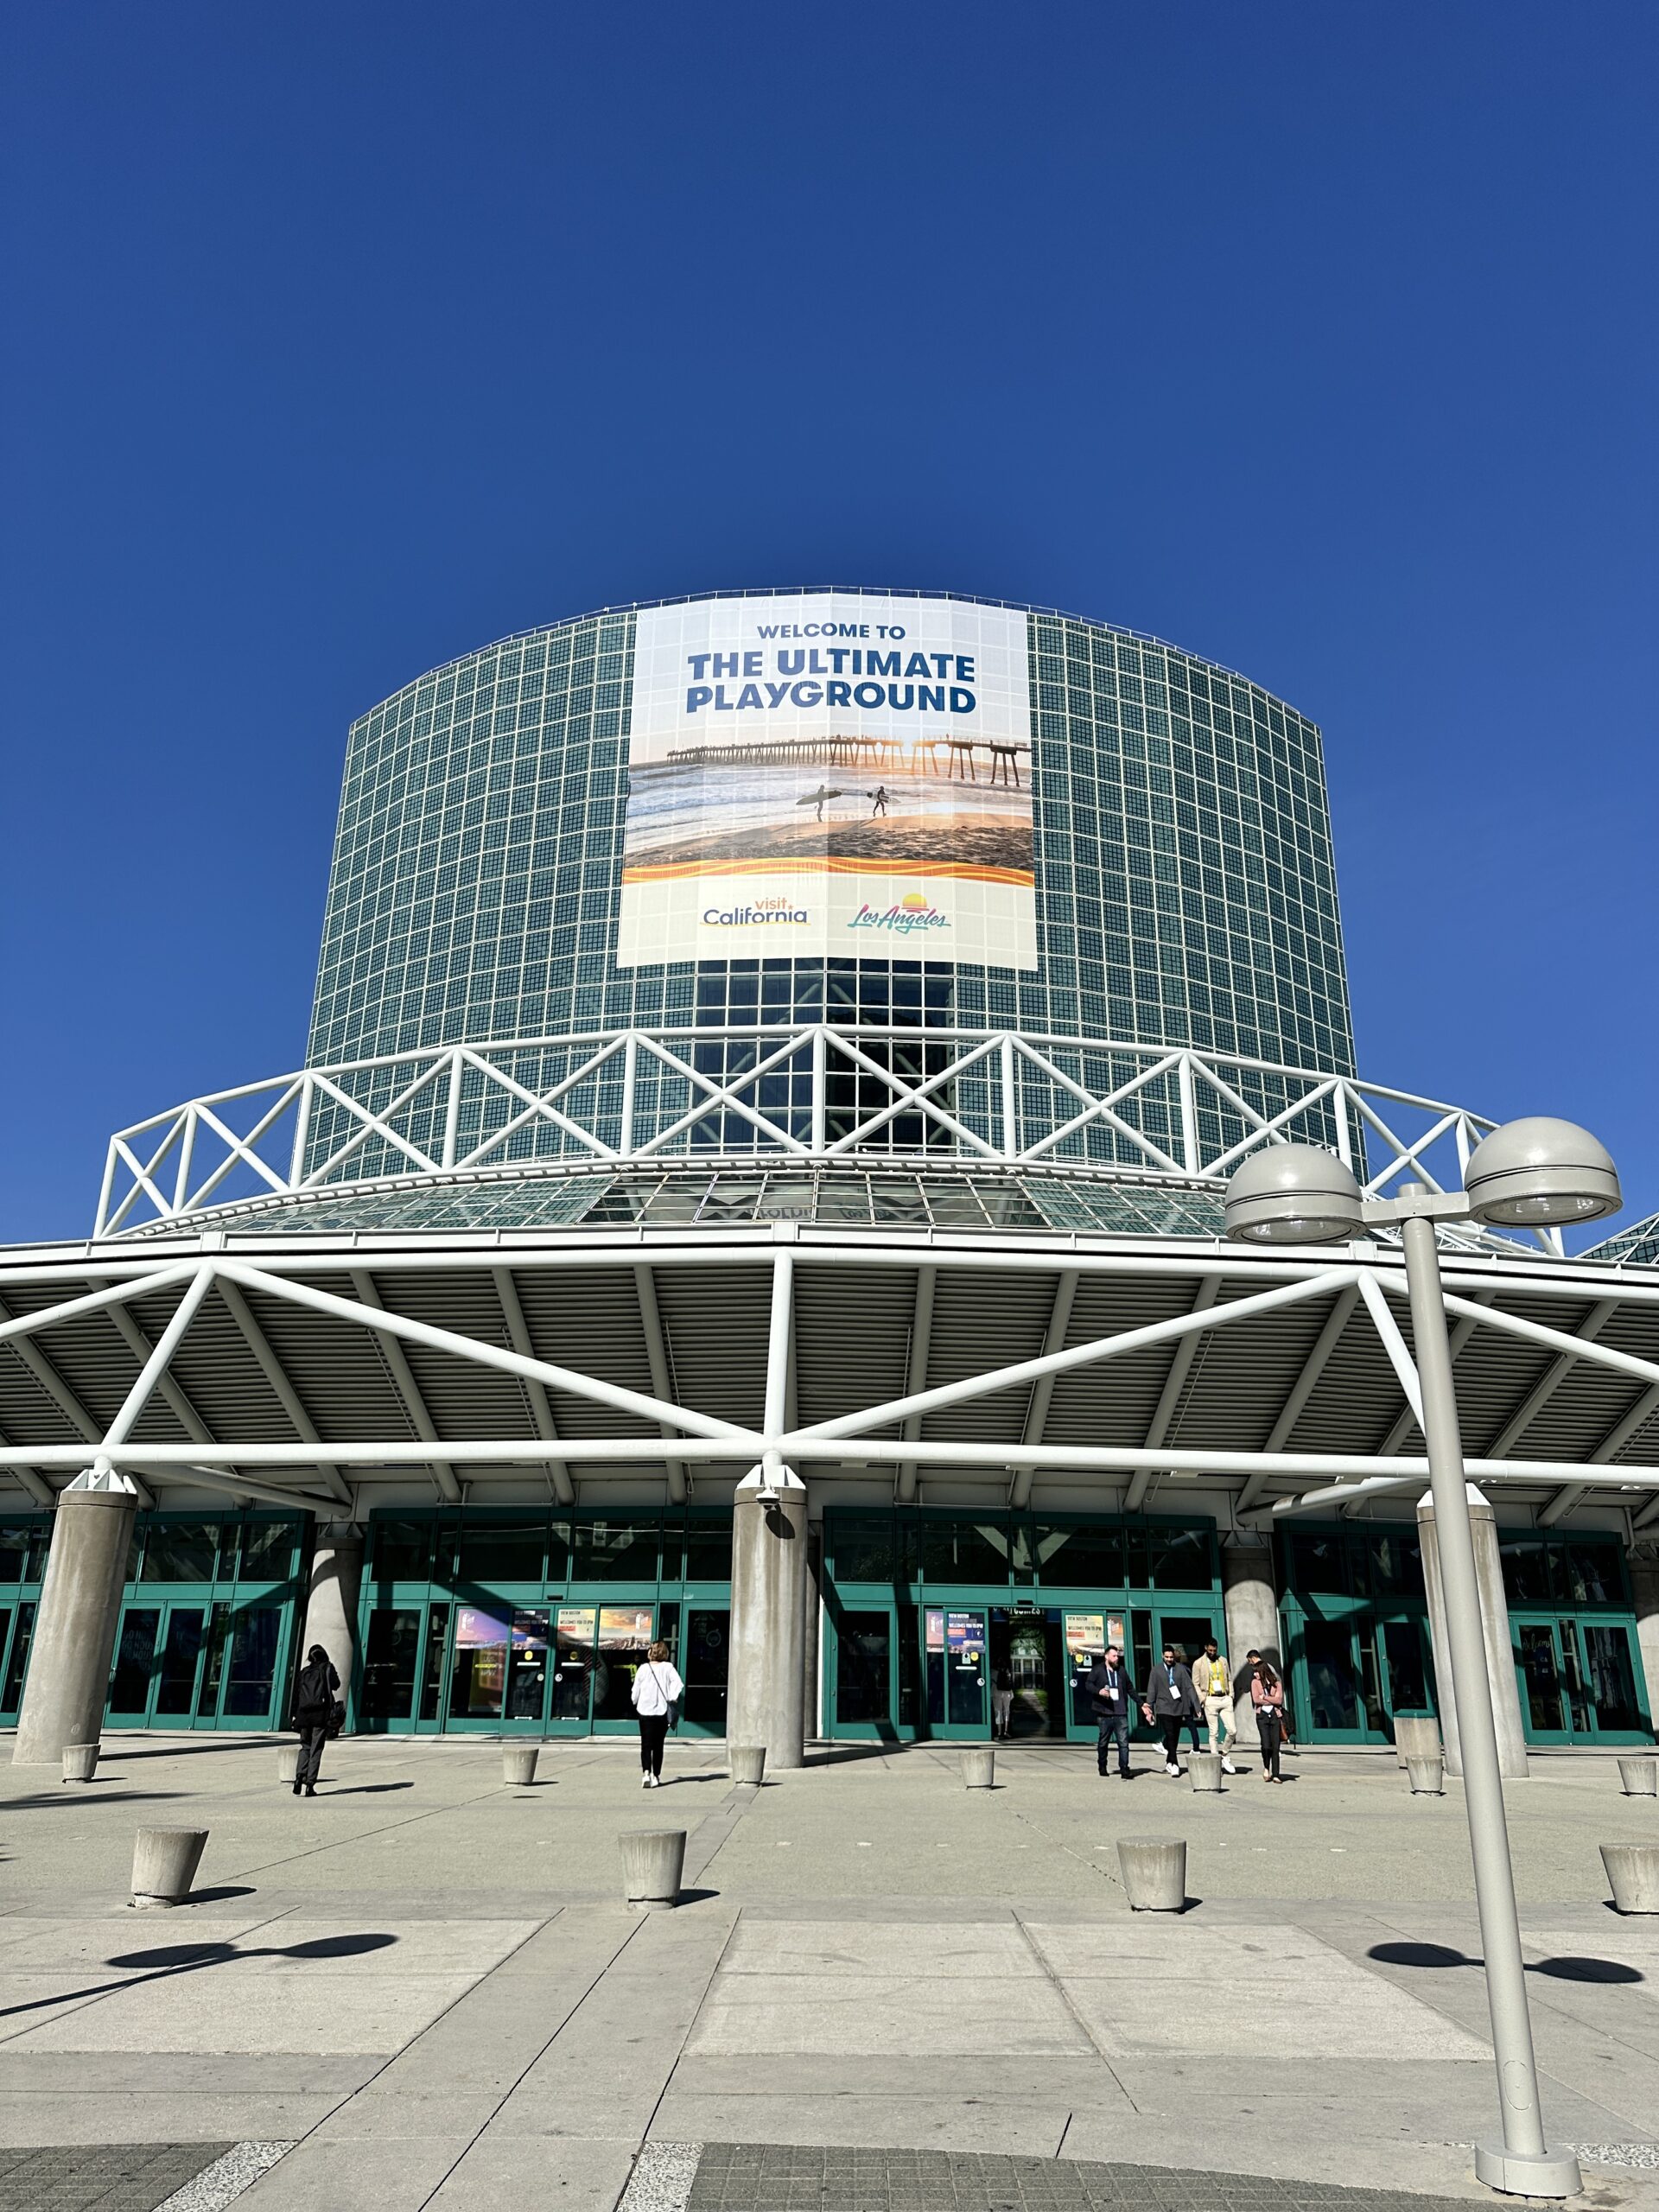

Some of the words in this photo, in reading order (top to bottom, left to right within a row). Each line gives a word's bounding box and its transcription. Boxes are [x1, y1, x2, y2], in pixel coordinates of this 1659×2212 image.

[757, 622, 869, 639] WELCOME
[876, 625, 906, 639] TO
[688, 651, 763, 680] THE
[778, 648, 975, 683] ULTIMATE
[686, 680, 976, 714] PLAYGROUND
[755, 897, 788, 910] visit
[703, 907, 808, 925] California
[847, 904, 878, 927] Los
[877, 905, 951, 934] Angeles
